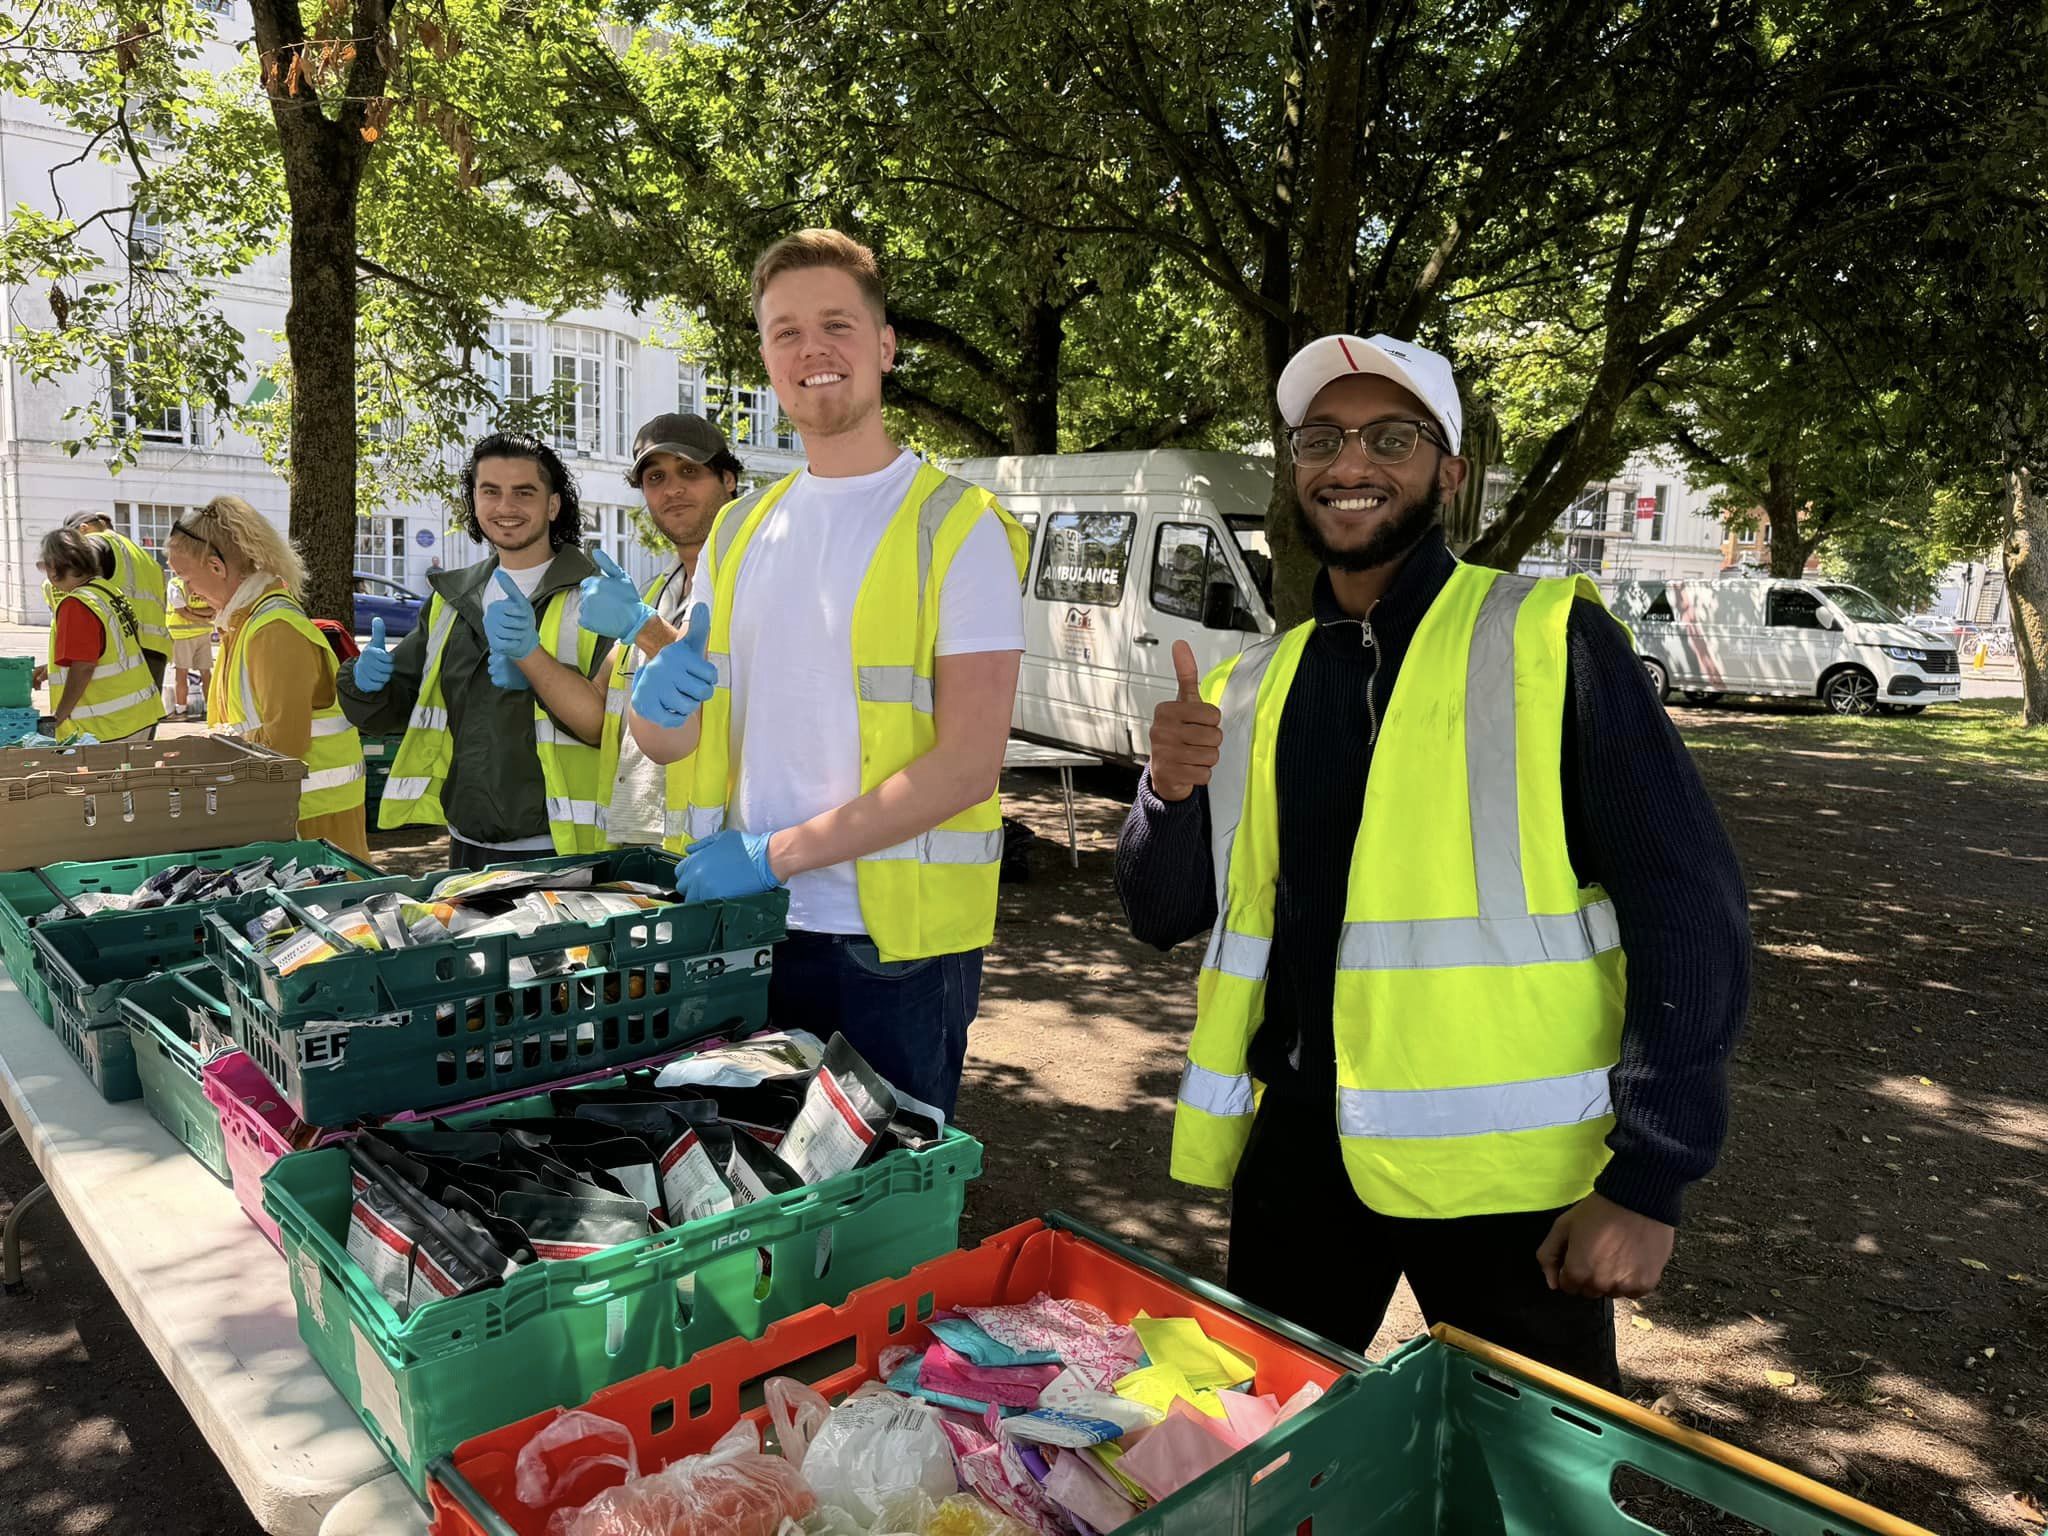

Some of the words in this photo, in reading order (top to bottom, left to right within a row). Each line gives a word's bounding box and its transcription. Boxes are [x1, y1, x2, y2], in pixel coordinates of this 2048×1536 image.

[1042, 566, 1119, 585] AMBULANCE
[731, 1169, 757, 1204] COUNTRY
[712, 1228, 751, 1251] IFCO
